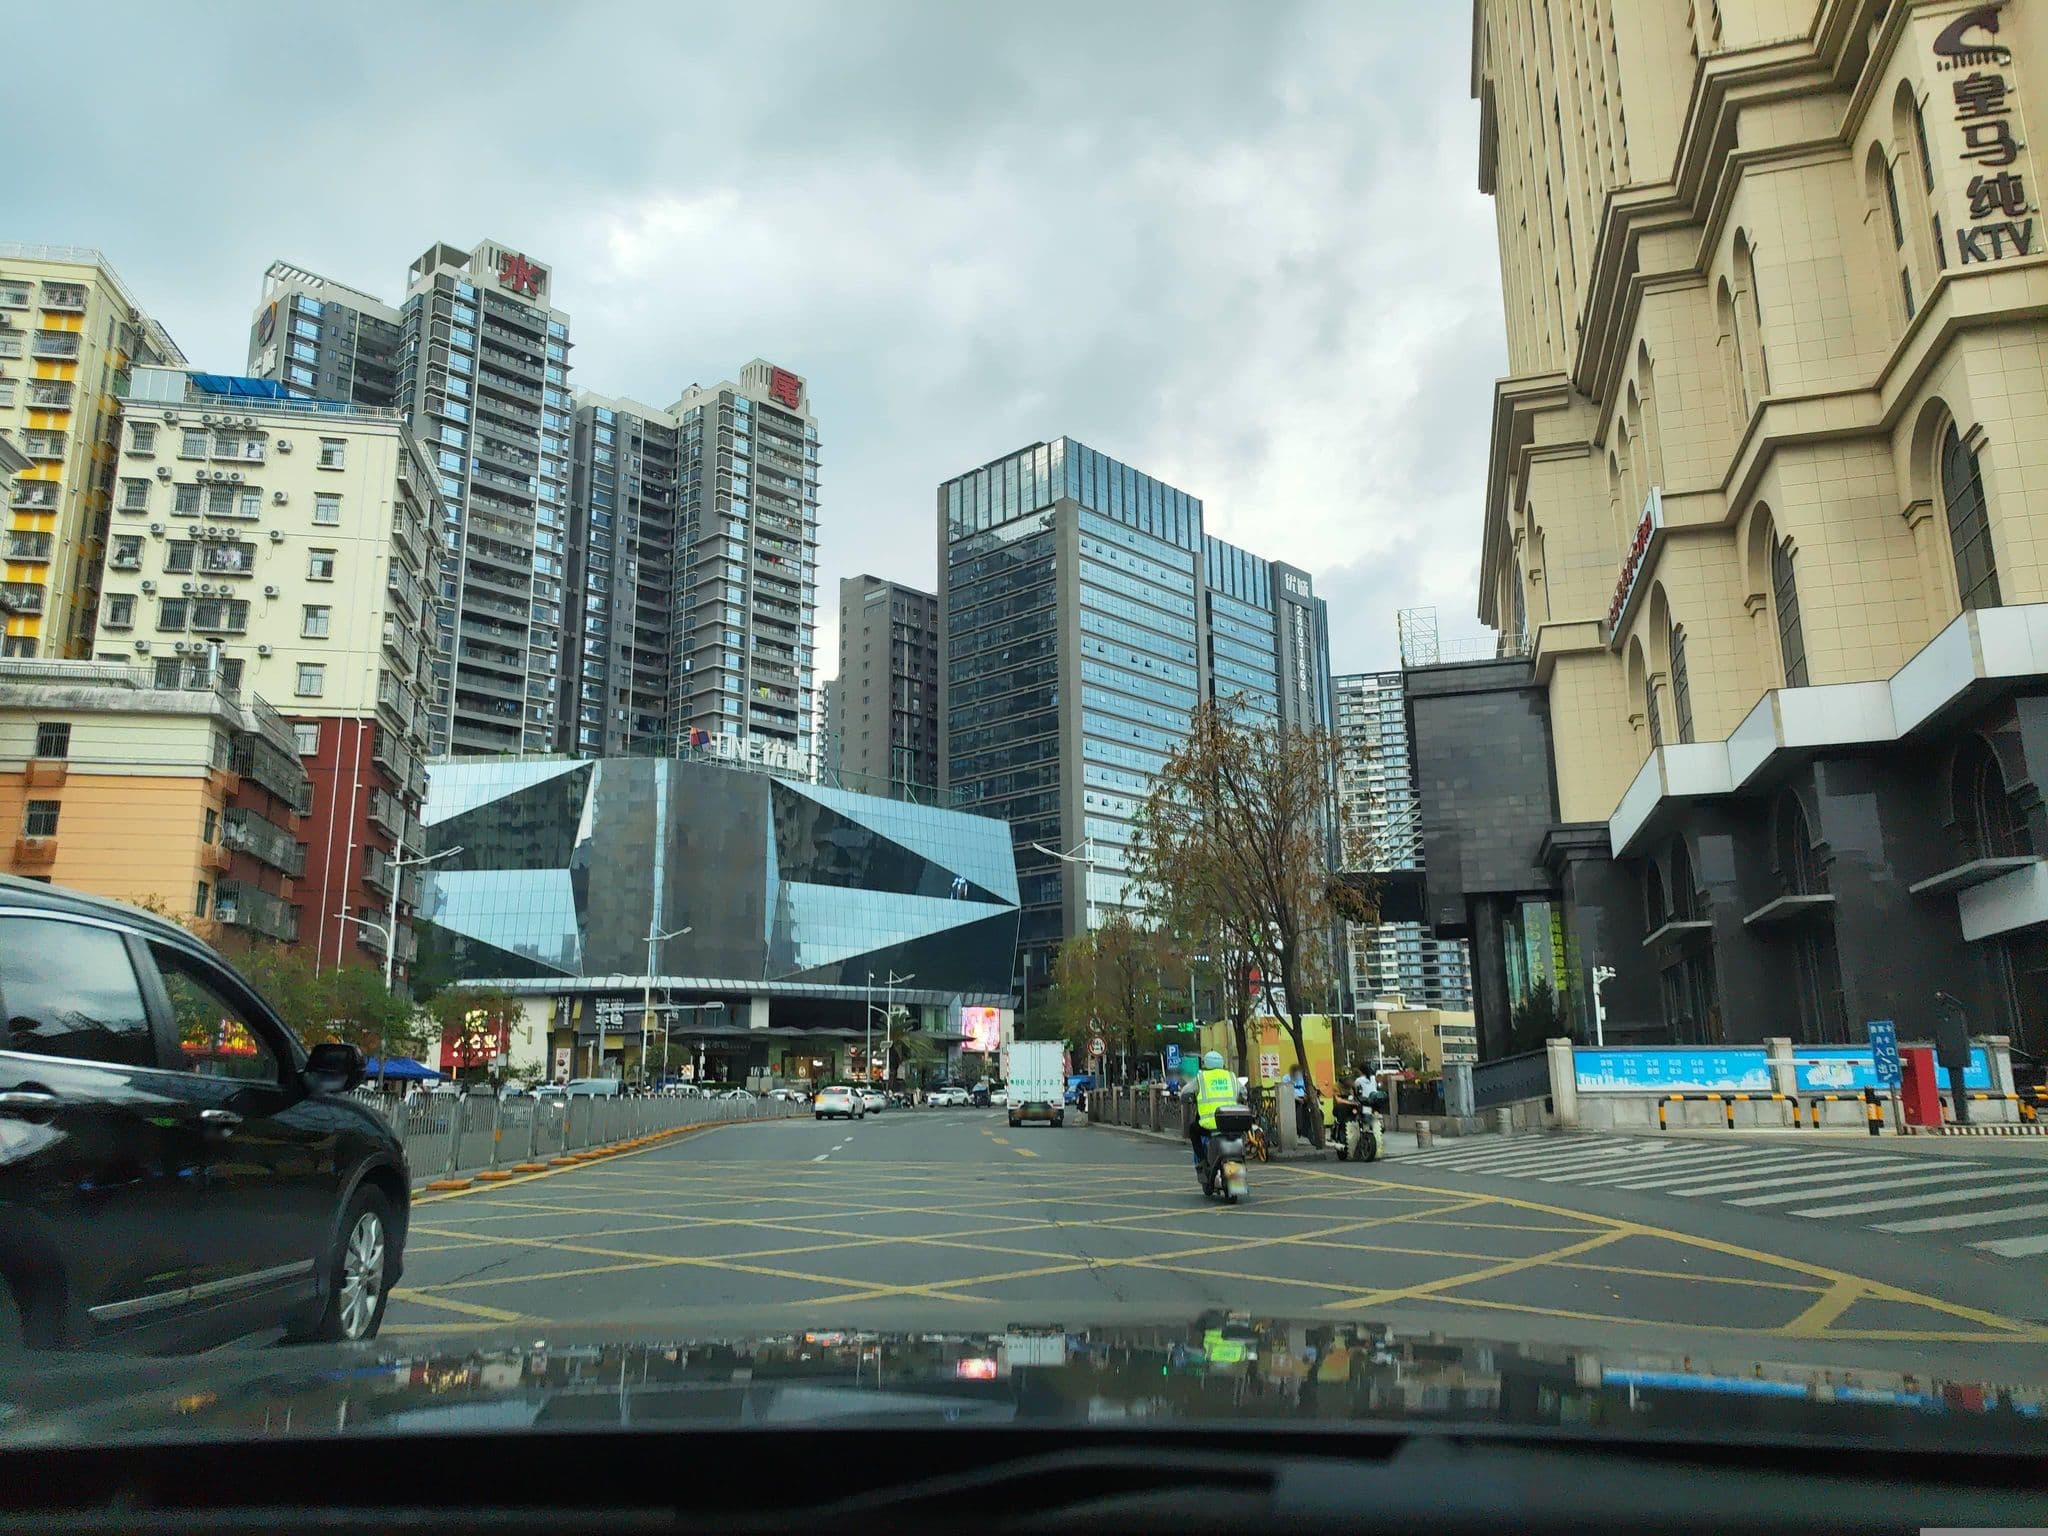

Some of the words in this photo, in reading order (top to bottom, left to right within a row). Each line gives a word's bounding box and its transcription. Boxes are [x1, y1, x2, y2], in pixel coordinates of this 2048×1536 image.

[1953, 71, 2028, 219] 皇马纯
[1956, 218, 2033, 265] KTV
[499, 253, 540, 297] 水
[1296, 605, 1307, 692] 28051666
[1168, 1046, 1176, 1057] P
[1875, 1046, 1896, 1057] 入口
[1877, 1063, 1899, 1074] 出口
